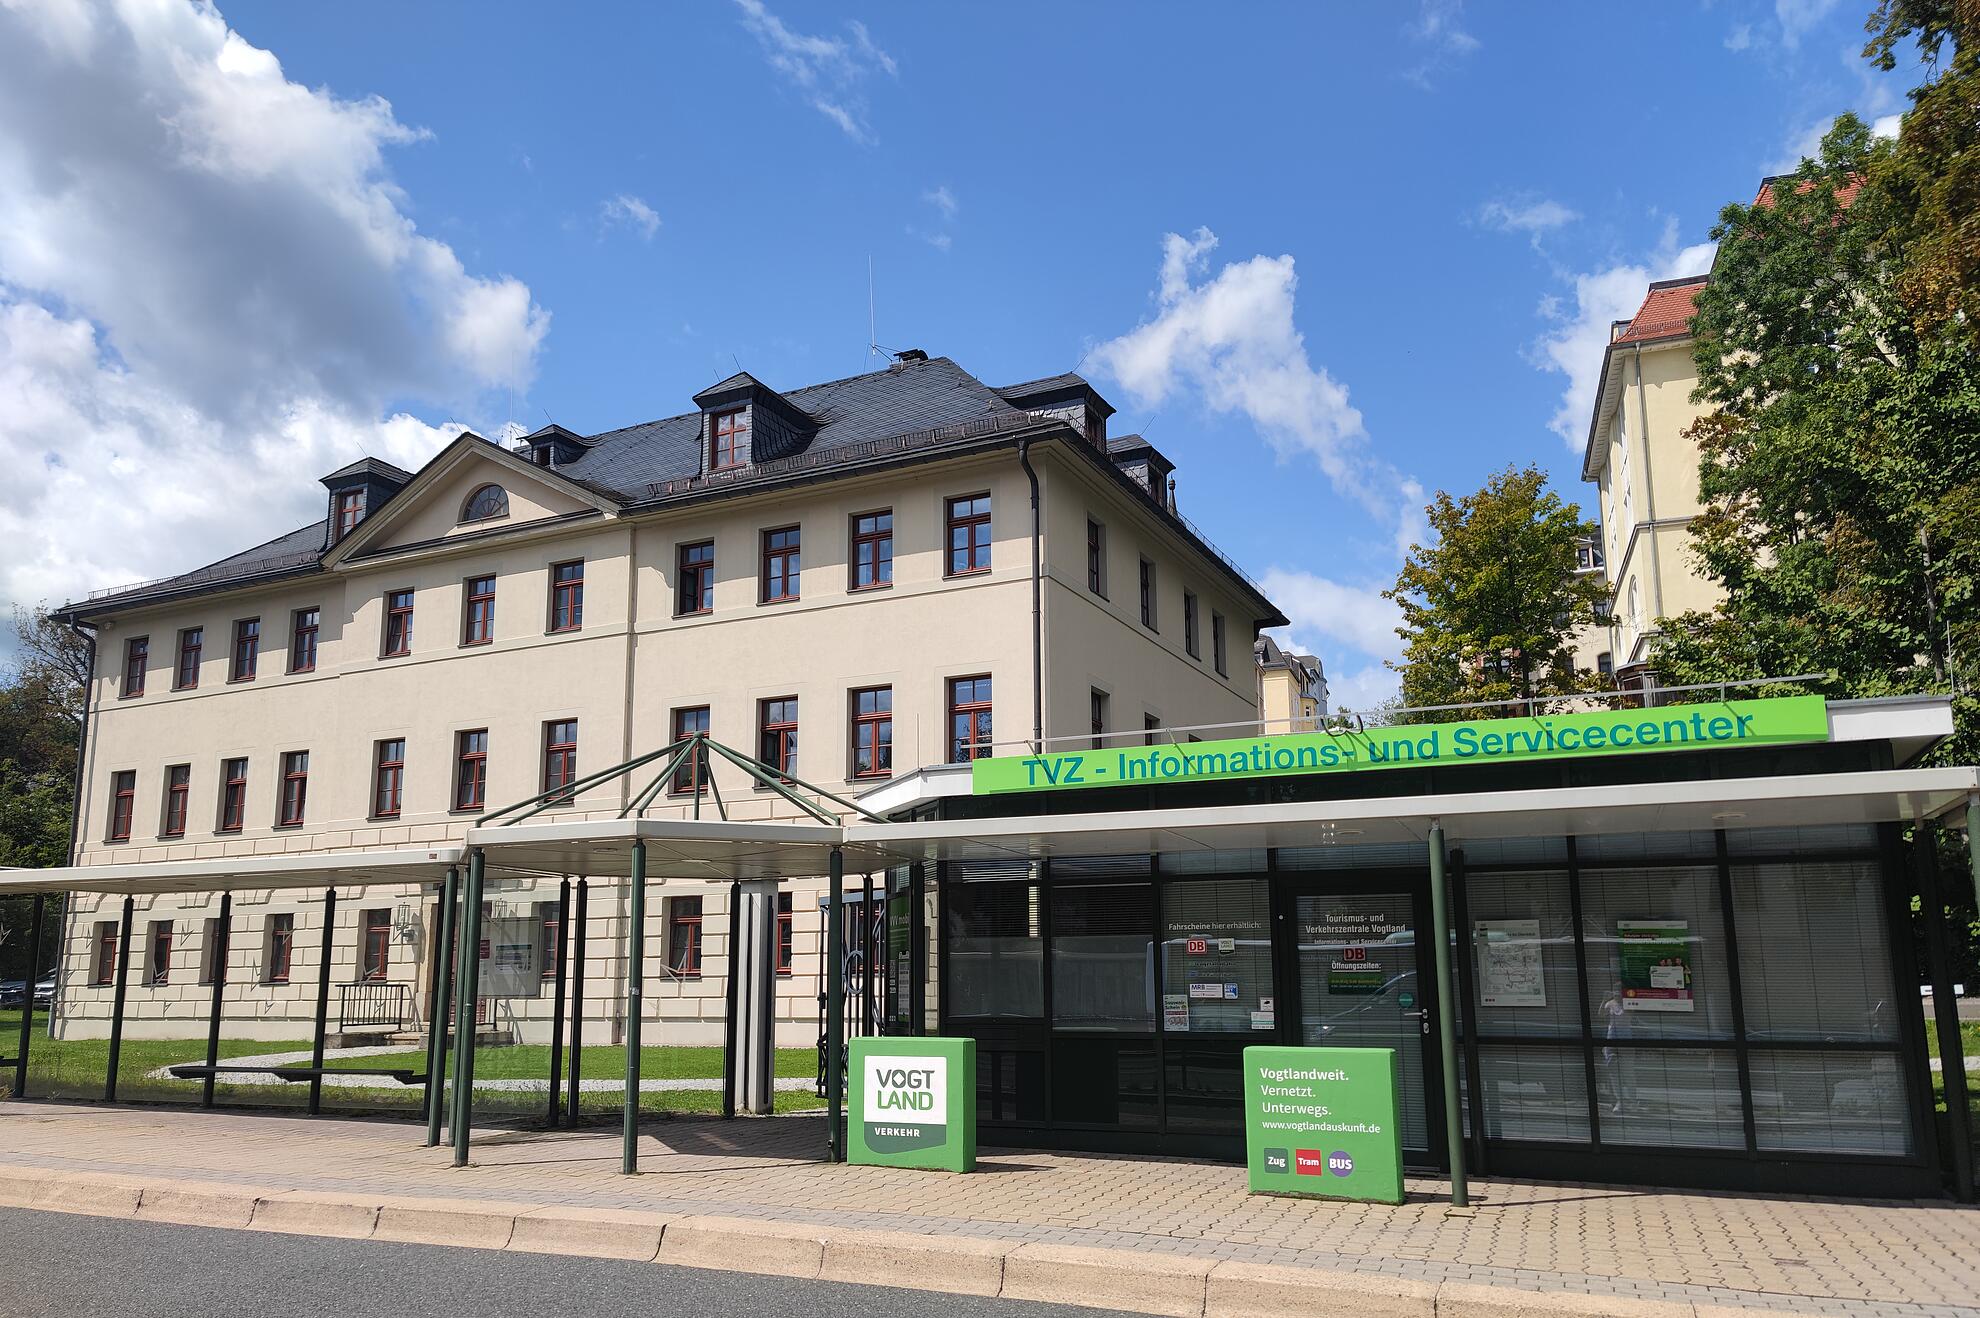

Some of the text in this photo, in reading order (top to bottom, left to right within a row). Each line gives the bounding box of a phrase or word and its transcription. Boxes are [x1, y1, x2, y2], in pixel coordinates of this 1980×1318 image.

[1022, 757, 1084, 786] TVZ
[1119, 743, 1354, 780] Informations-
[1369, 731, 1439, 763] und
[1453, 712, 1753, 757] Servicecenter
[1325, 913, 1384, 923] Tourismus- und
[1168, 923, 1210, 931] Fahrscheine
[1211, 922, 1225, 930] hier
[1305, 924, 1406, 934] Verkehrszentrale Vogtland
[1344, 948, 1365, 960] DB
[1331, 960, 1382, 971] Öffnungszeiten:
[876, 1069, 935, 1089] VOGT
[1260, 1067, 1349, 1082] Vogtlandweit.
[1260, 1085, 1316, 1098] Vernetzt.
[877, 1090, 934, 1110] LAND
[1262, 1102, 1332, 1117] Unterwegs.
[874, 1127, 920, 1137] VERKEHR
[1262, 1121, 1381, 1134] www.vogtlandauskunft.de
[1267, 1156, 1286, 1168] Zug
[1298, 1157, 1319, 1167] Tram
[1329, 1158, 1353, 1170] BUS
